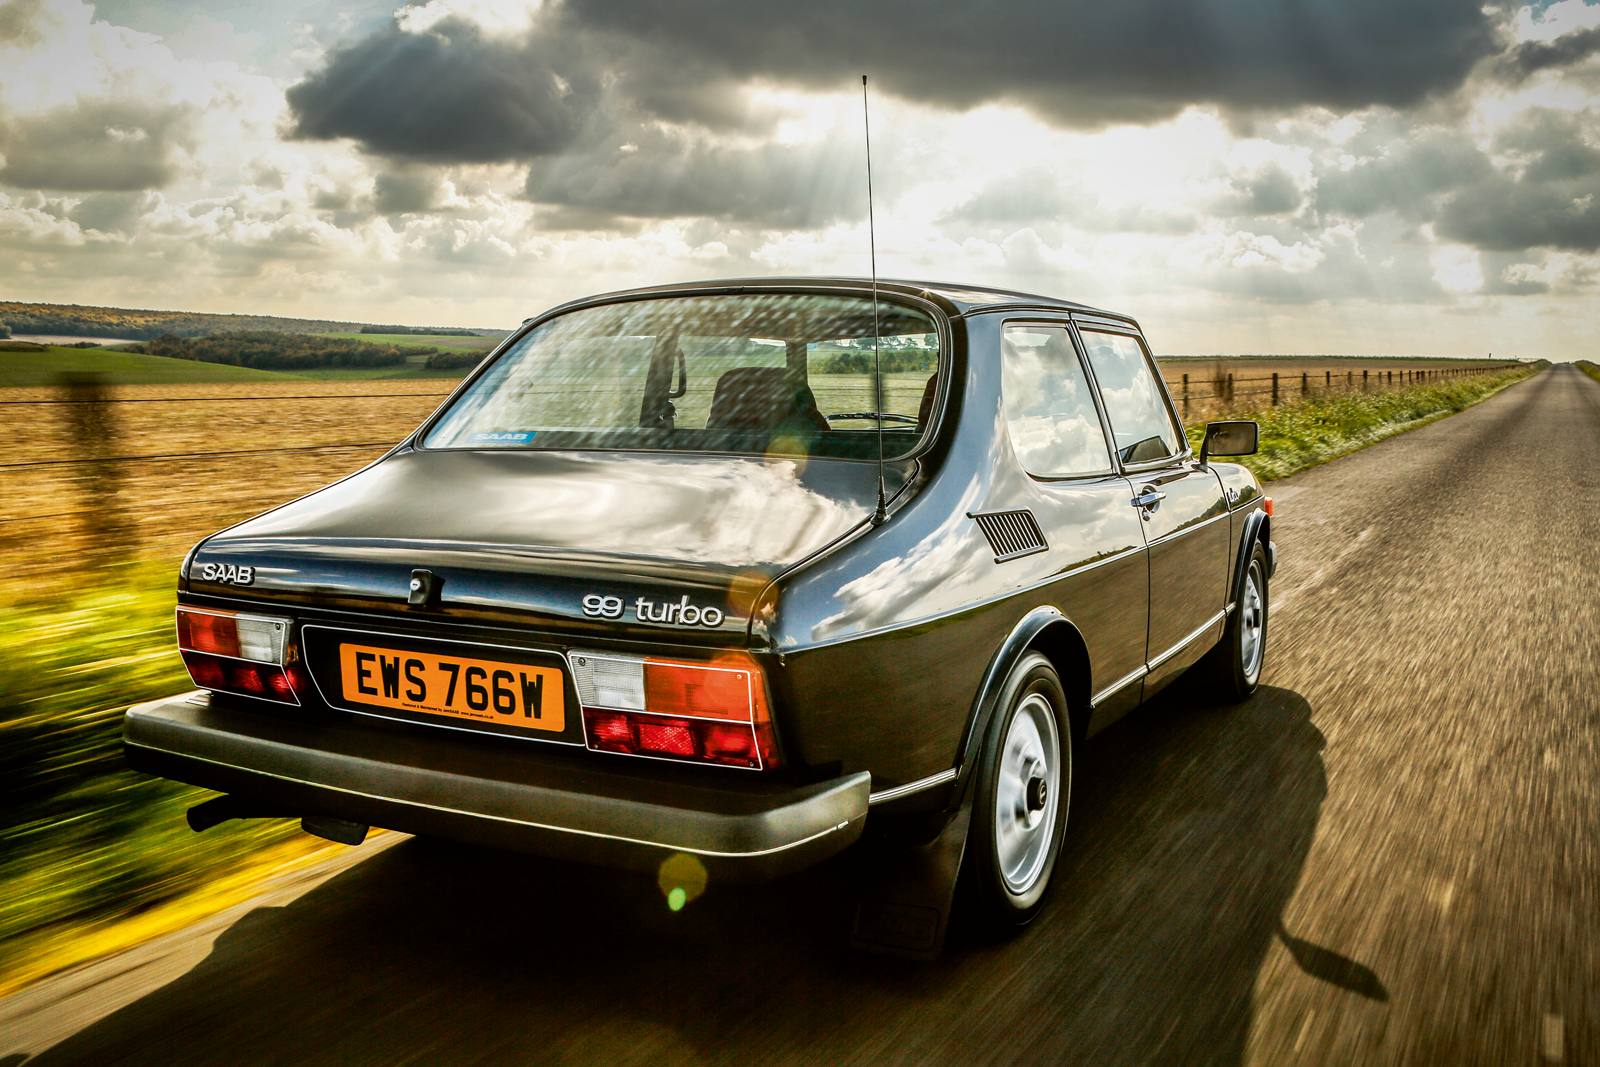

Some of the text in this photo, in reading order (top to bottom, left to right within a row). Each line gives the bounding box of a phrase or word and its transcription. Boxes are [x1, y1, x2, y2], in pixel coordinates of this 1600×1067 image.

[202, 563, 252, 584] SAAB
[582, 594, 724, 626] 99 turbo
[356, 652, 544, 719] EWS 766W
